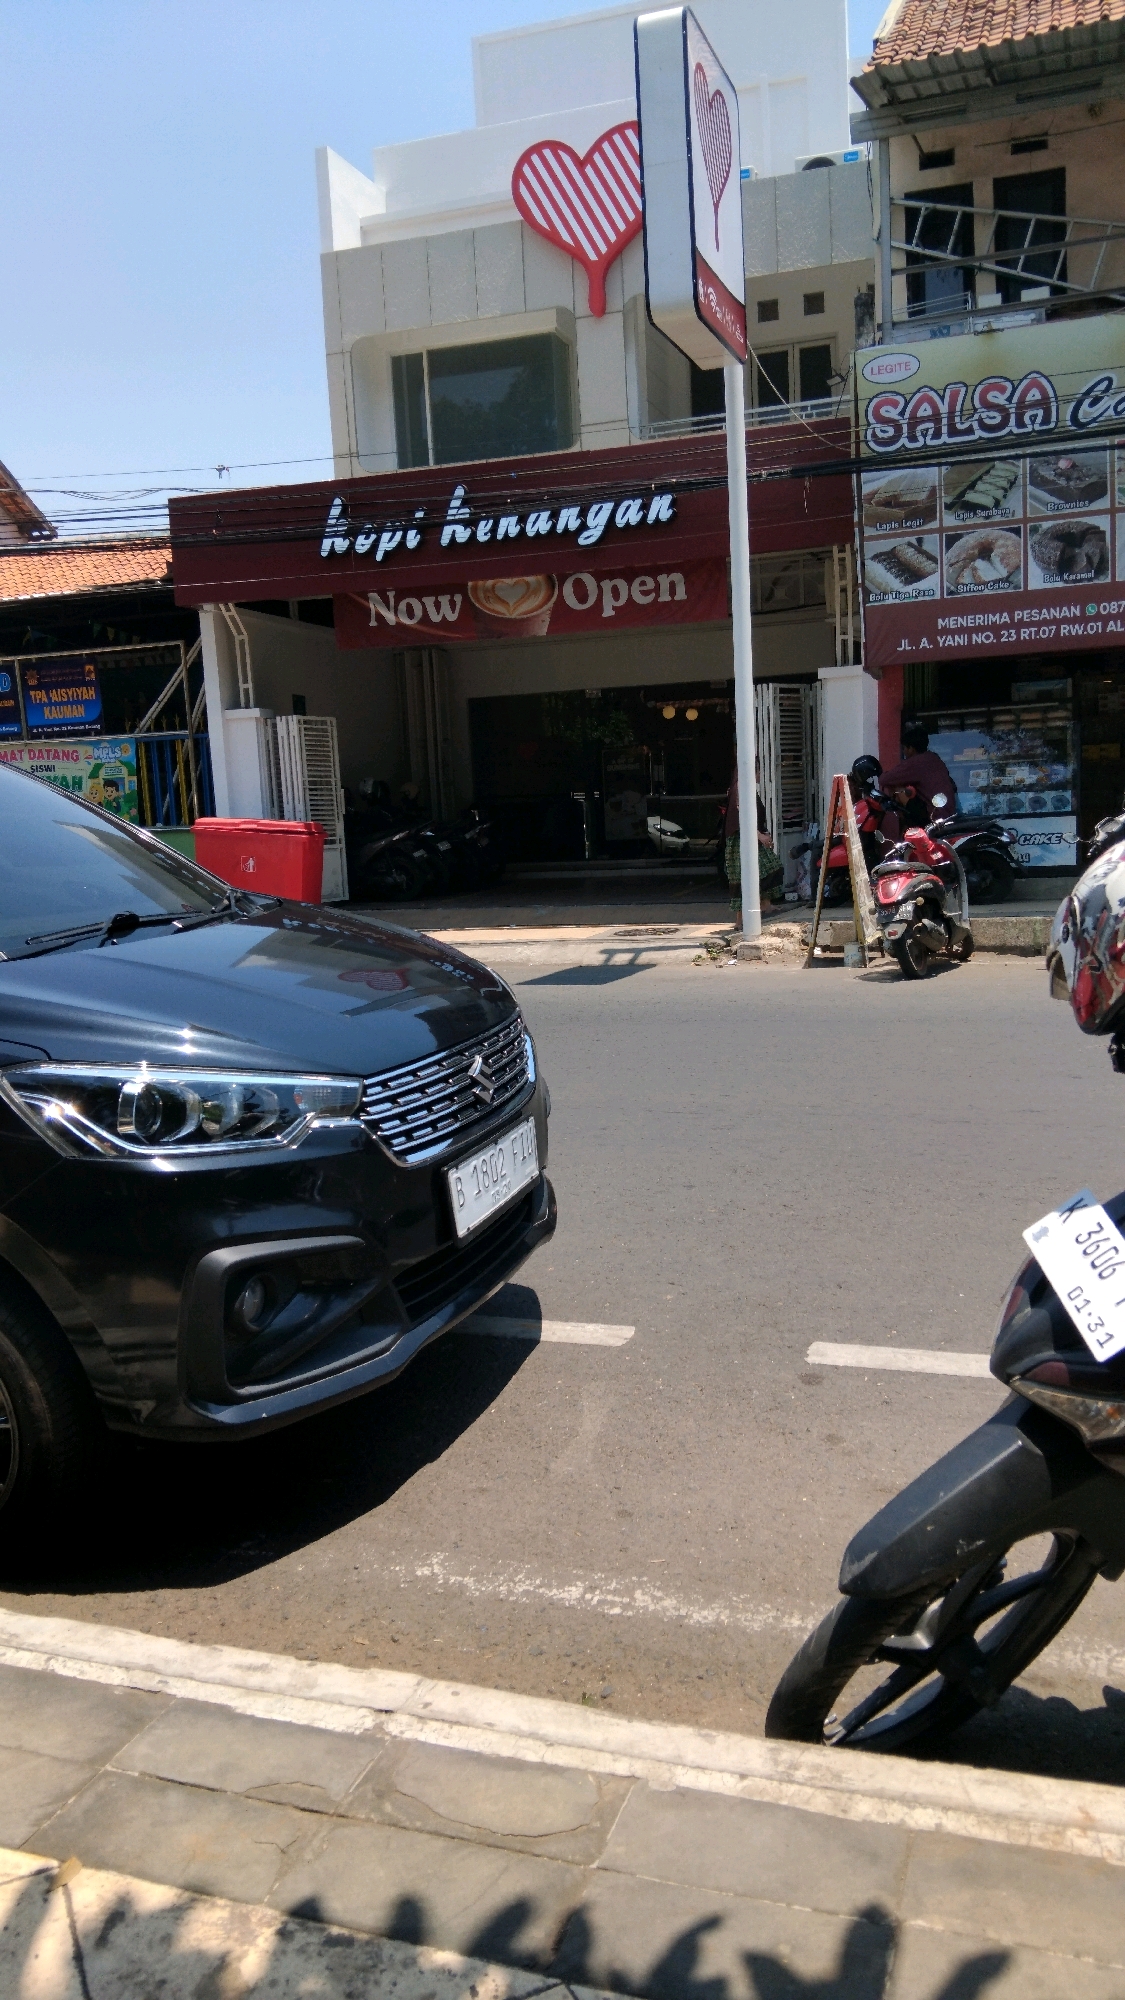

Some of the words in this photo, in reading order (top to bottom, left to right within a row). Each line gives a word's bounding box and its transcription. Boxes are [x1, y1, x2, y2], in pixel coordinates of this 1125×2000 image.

[870, 361, 912, 376] LEGITE
[866, 371, 1059, 452] SALSA
[1047, 500, 1090, 511] Brownies
[955, 511, 974, 521] Lapis
[976, 507, 1010, 518] Surabaya
[876, 521, 899, 532] Lapis
[902, 518, 924, 530] Legit
[1044, 573, 1061, 583] Bolu
[1063, 569, 1095, 581] Karamel
[957, 583, 984, 593] Siffon
[987, 581, 1010, 590] Cake
[368, 590, 463, 627] Now
[562, 572, 687, 617] Open
[869, 592, 889, 602] Bolu
[890, 590, 910, 601] Tiga
[912, 588, 934, 598] Rasa
[937, 612, 1010, 629] MENERIMA
[1014, 605, 1080, 623] PESANAN
[897, 639, 916, 651] JL.
[919, 637, 933, 649] A.
[937, 633, 968, 647] YANI
[971, 631, 997, 645] NO.
[1000, 629, 1017, 642] 23
[1020, 625, 1057, 640] RT.07
[1060, 621, 1102, 637] RW.01
[29, 690, 48, 704] TPA
[43, 704, 85, 719] KAUMAN
[28, 748, 80, 762] DATANG
[93, 746, 122, 759] MPLS
[30, 764, 56, 774] SISWI
[1018, 833, 1063, 846] CAKE
[455, 1176, 466, 1208] B
[471, 1147, 507, 1196] 1802
[1058, 1197, 1089, 1224] K
[1074, 1221, 1125, 1280] 3606
